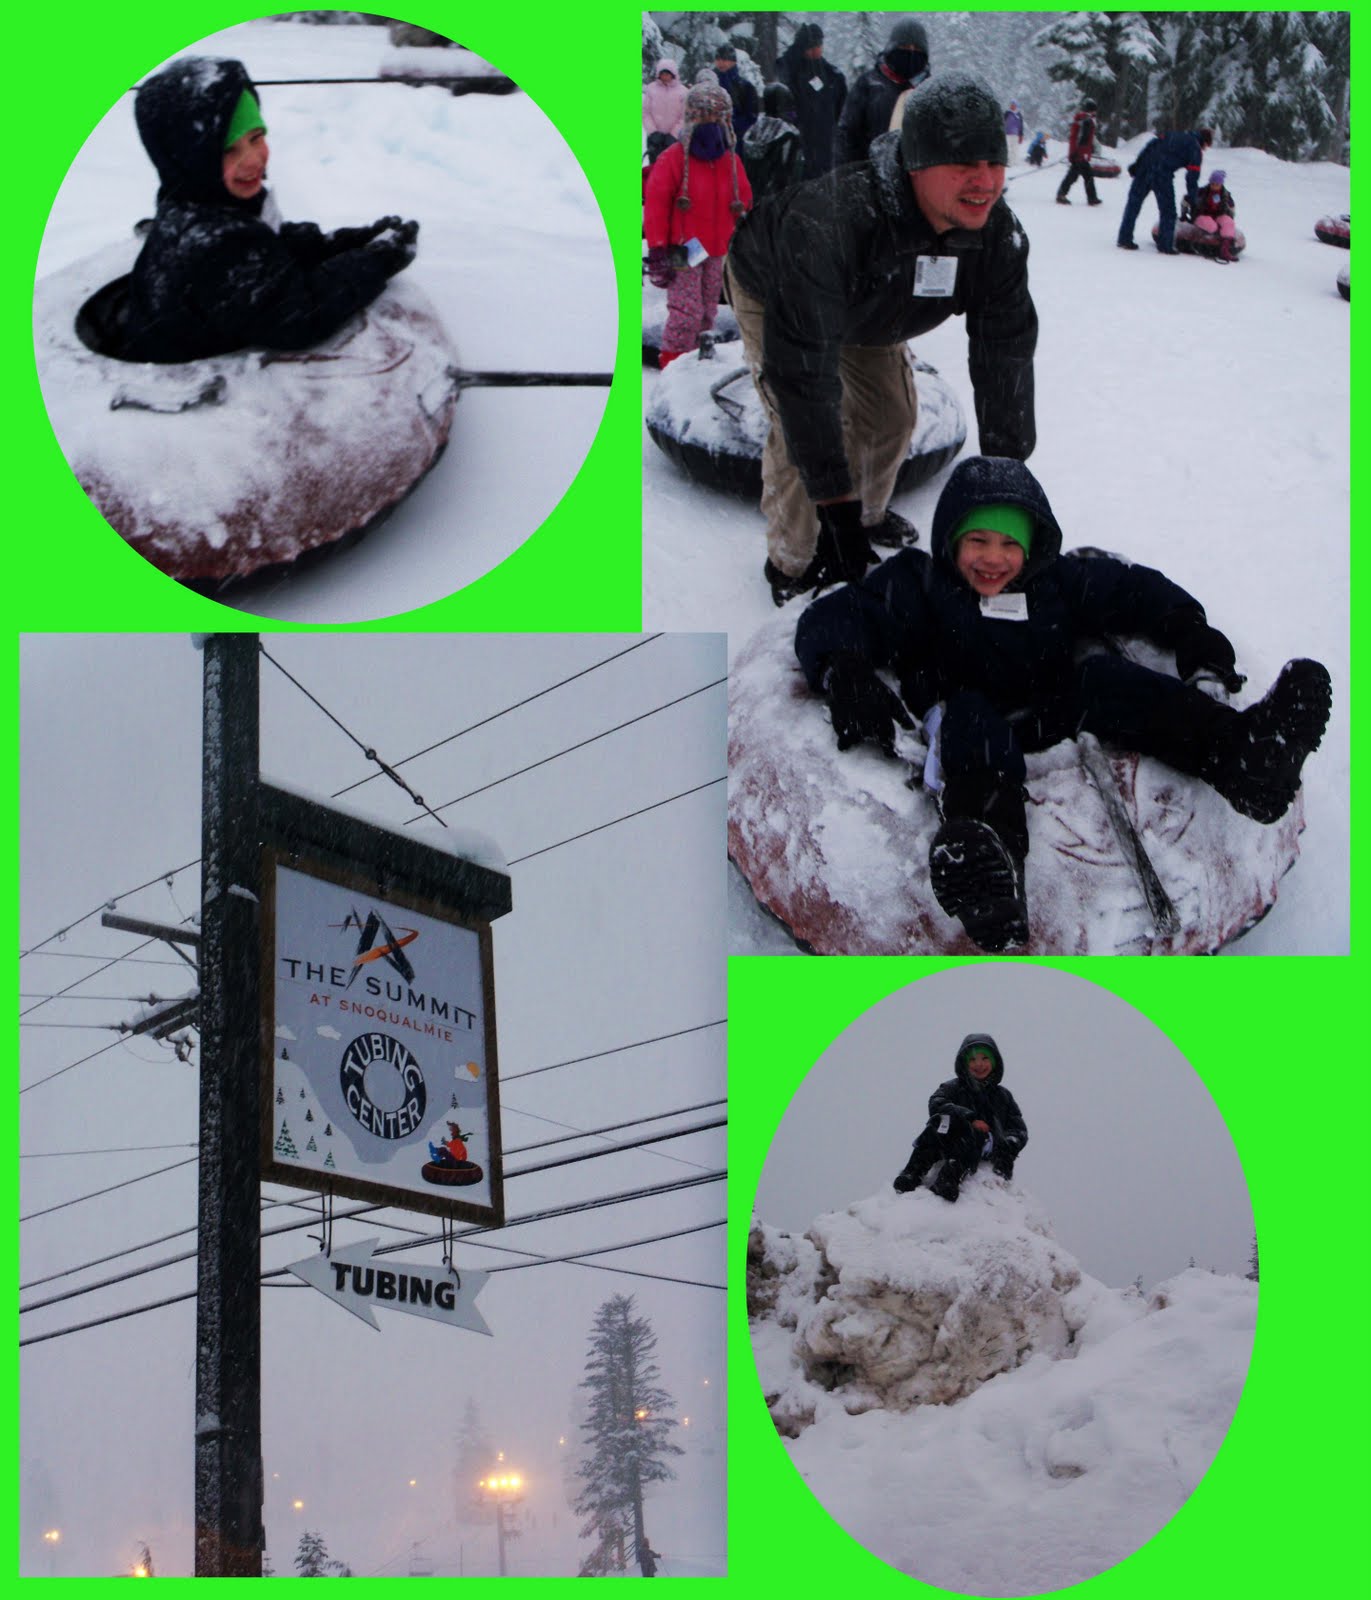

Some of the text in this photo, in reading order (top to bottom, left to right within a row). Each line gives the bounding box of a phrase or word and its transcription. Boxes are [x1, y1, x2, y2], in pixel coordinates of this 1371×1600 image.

[282, 958, 476, 1030] THE SUMMIT
[310, 993, 453, 1042] AT SNOQUALMIE
[344, 1034, 423, 1092] TUBING
[347, 1084, 421, 1139] CENTER
[330, 1262, 455, 1310] TUBING
